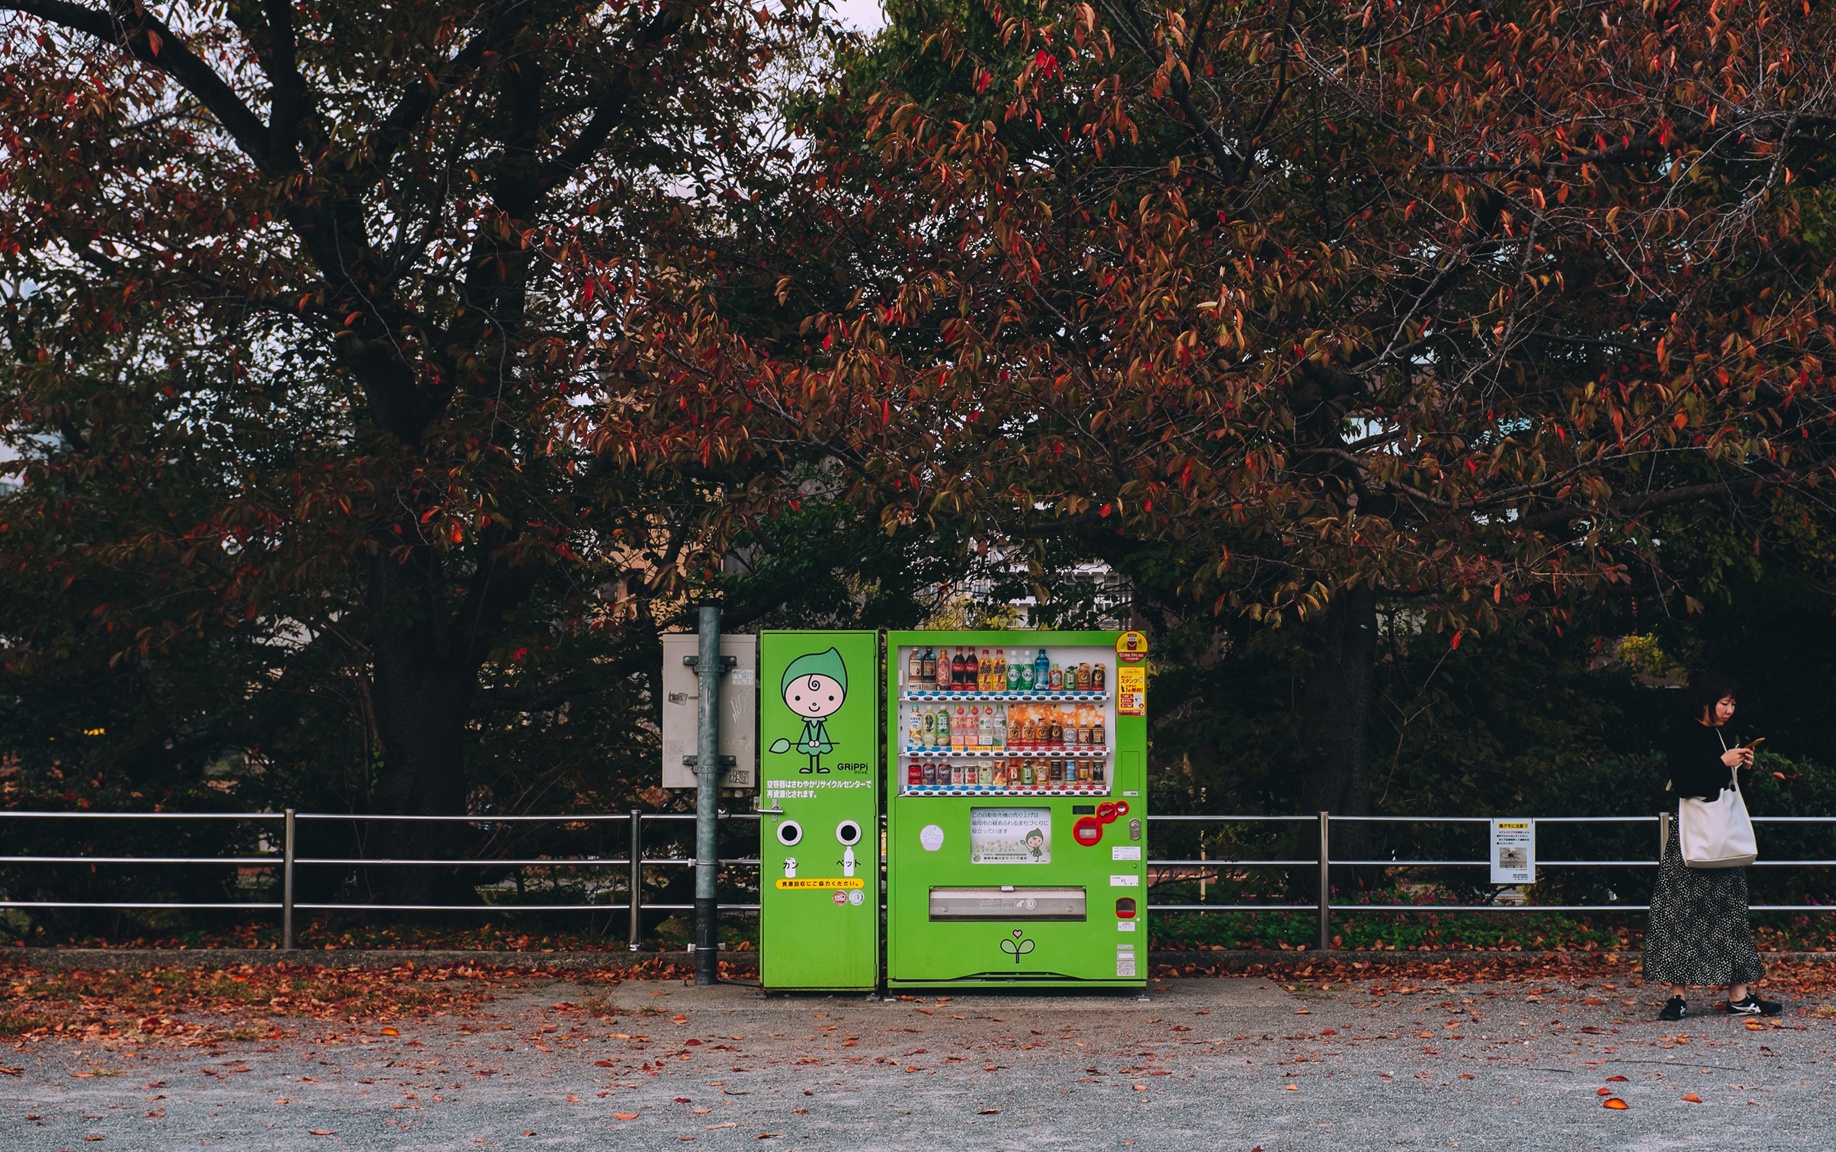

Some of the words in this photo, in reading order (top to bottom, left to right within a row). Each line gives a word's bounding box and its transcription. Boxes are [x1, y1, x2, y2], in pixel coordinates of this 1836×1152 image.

[767, 780, 872, 789] 空容器はさわやかリサイクルセンターで
[767, 790, 817, 798] 再資源化されます。
[783, 861, 799, 870] カン
